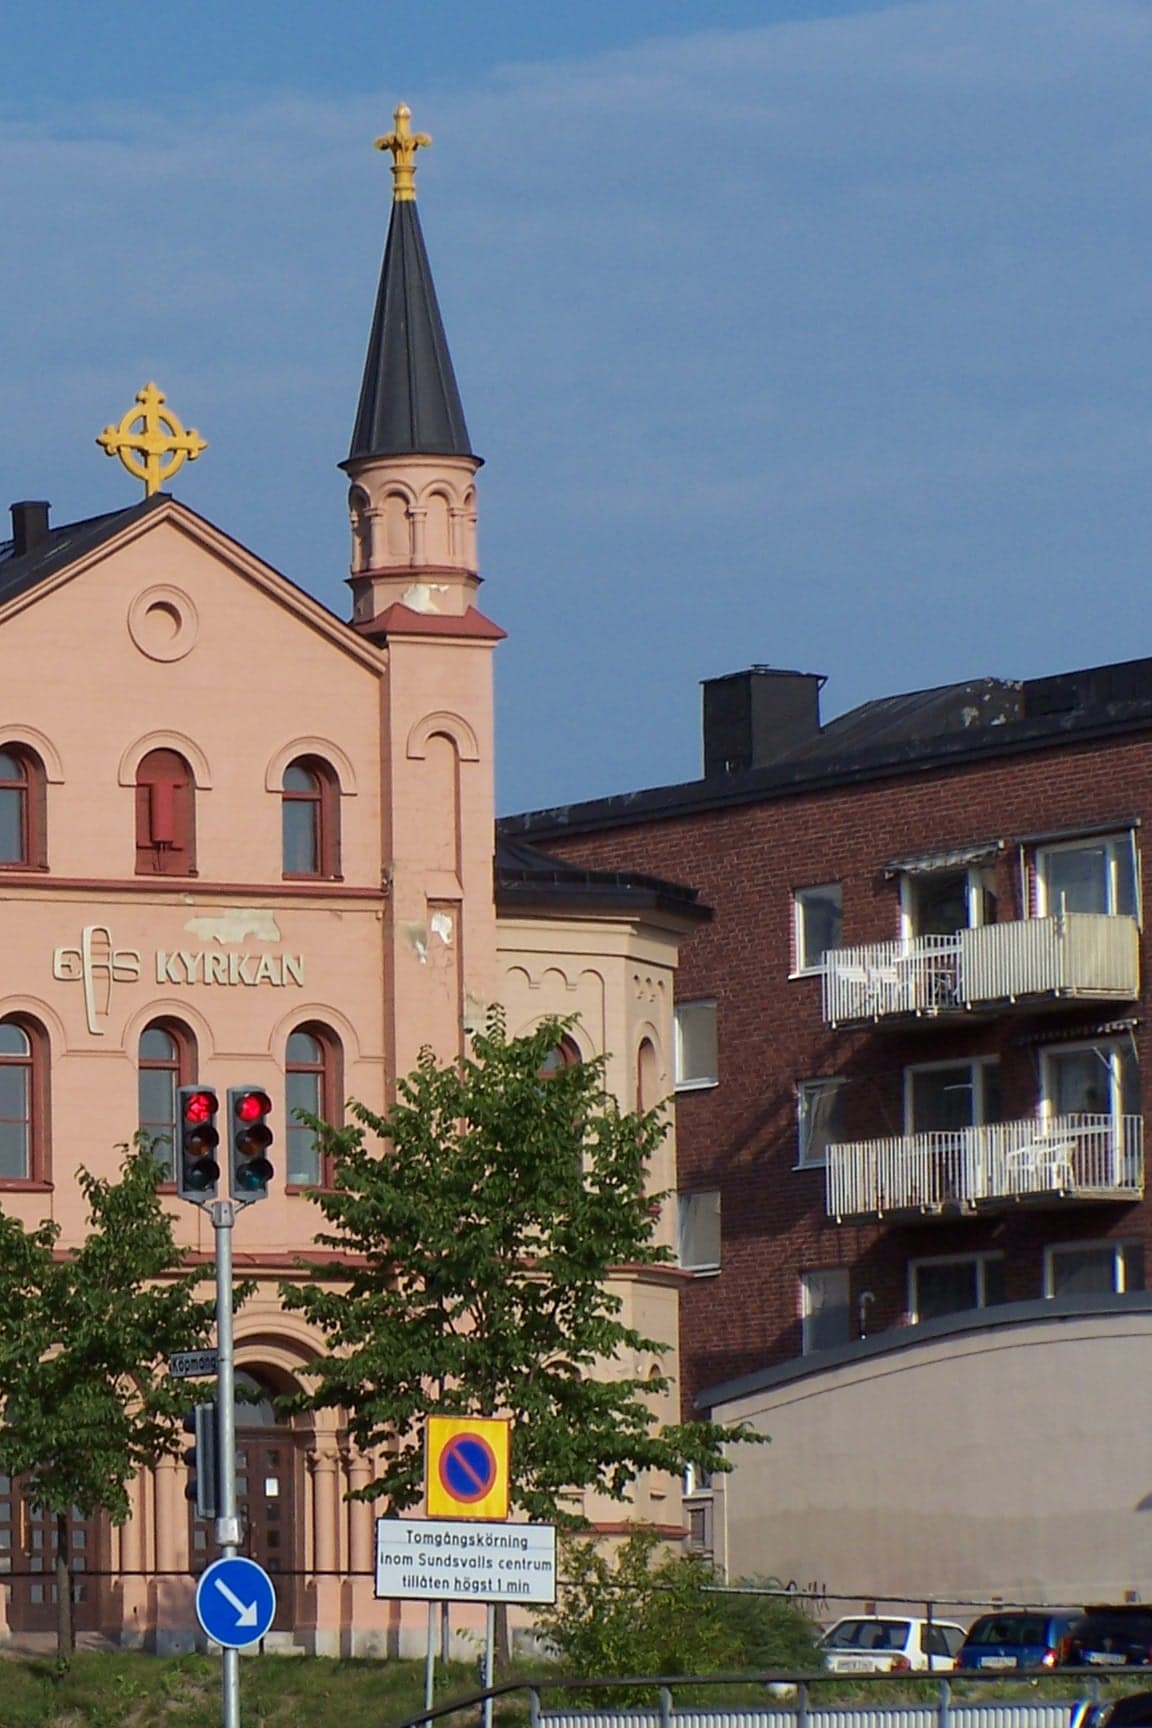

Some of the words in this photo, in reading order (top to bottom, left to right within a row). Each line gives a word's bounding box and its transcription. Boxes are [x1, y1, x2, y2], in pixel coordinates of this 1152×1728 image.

[156, 951, 304, 987] KYRKAN
[406, 1530, 529, 1550] Tomgångskörning
[380, 1552, 413, 1566] inom
[418, 1553, 493, 1569] Sundsvalls
[498, 1558, 552, 1571] centrum
[402, 1575, 450, 1589] tillåten
[454, 1577, 493, 1593] högst
[497, 1578, 503, 1591] 1
[506, 1579, 530, 1592] min
